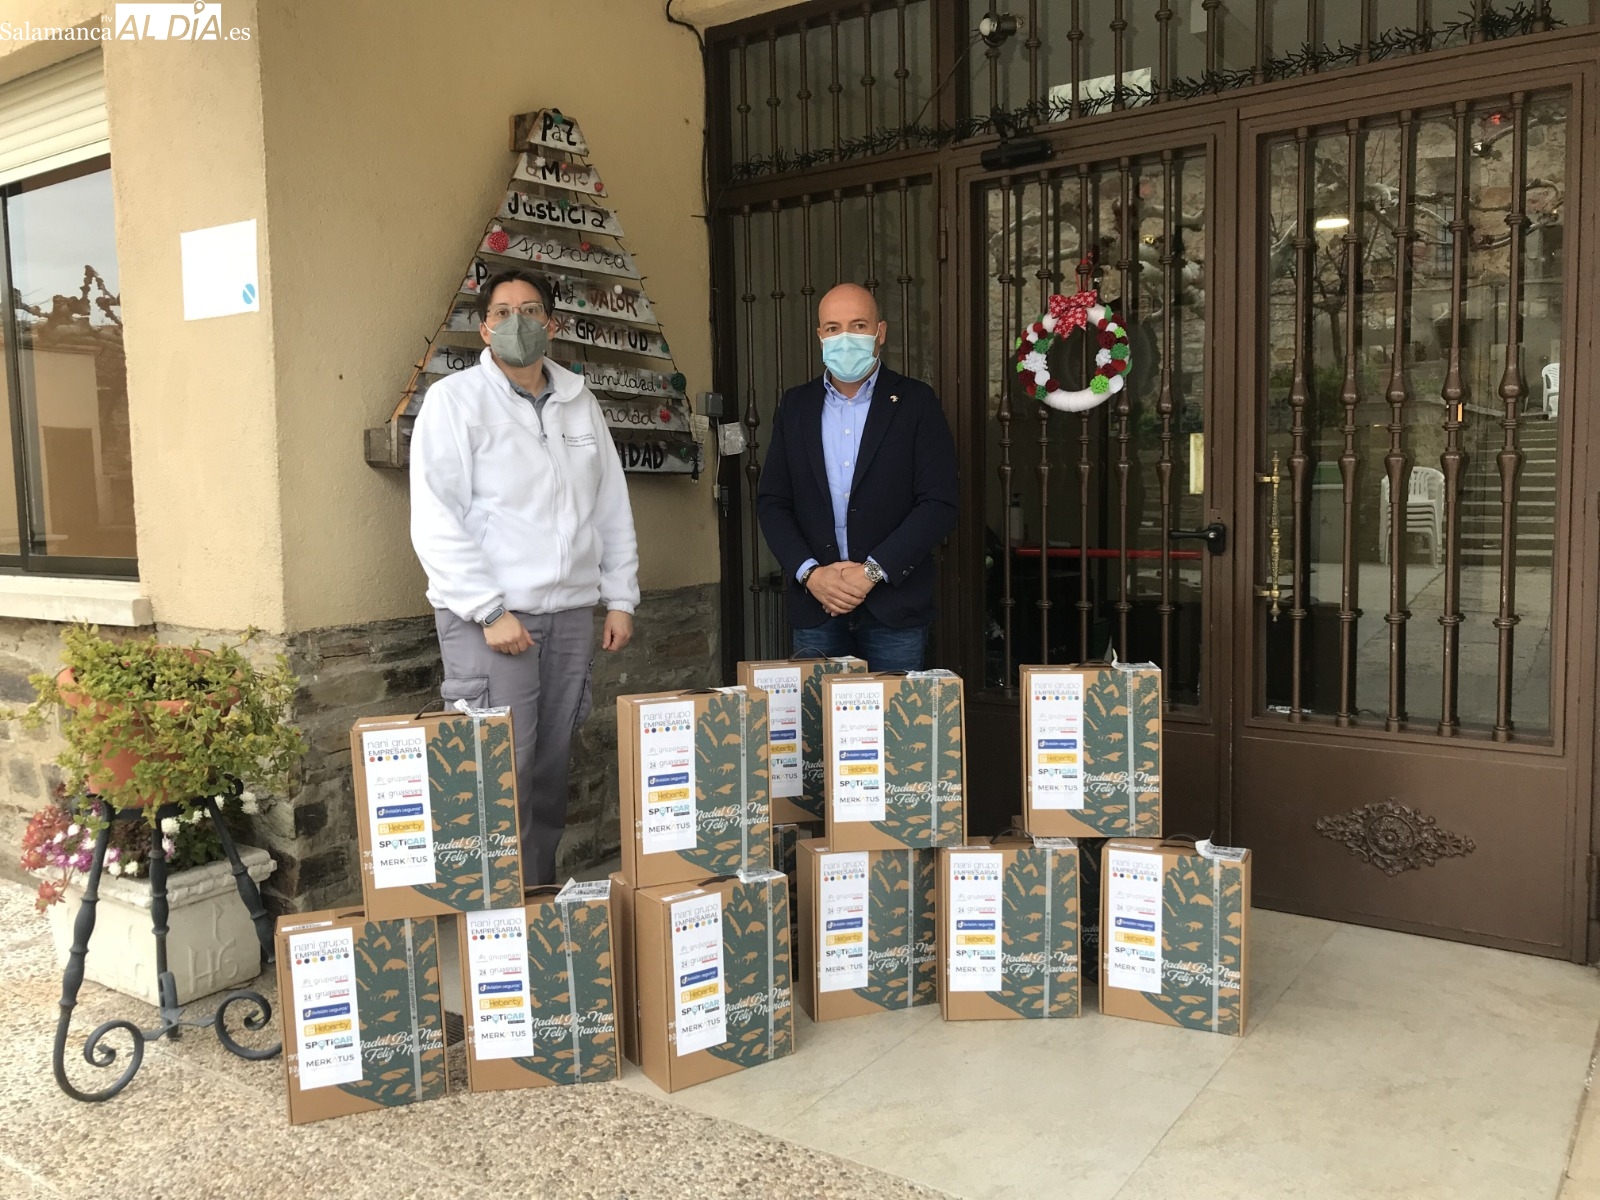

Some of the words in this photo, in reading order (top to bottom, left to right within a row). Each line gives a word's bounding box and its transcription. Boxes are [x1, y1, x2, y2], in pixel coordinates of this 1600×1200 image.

[507, 191, 606, 229] Justicia
[575, 318, 649, 350] GRATITUD
[835, 691, 853, 699] nani
[643, 711, 663, 721] nani
[644, 718, 691, 728] EMPRESARIAL
[367, 738, 389, 749] nani
[391, 737, 422, 749] grupo
[368, 746, 422, 756] EMPRESARIAL
[470, 918, 491, 928] nani
[493, 917, 523, 928] grupo
[471, 926, 522, 935] EMPRESARIAL
[293, 940, 316, 952] nani
[318, 937, 349, 950] grupo
[294, 946, 349, 959] EMPRESARIAL
[825, 963, 864, 973] MERKTUS
[1114, 963, 1156, 974] MERKTUS
